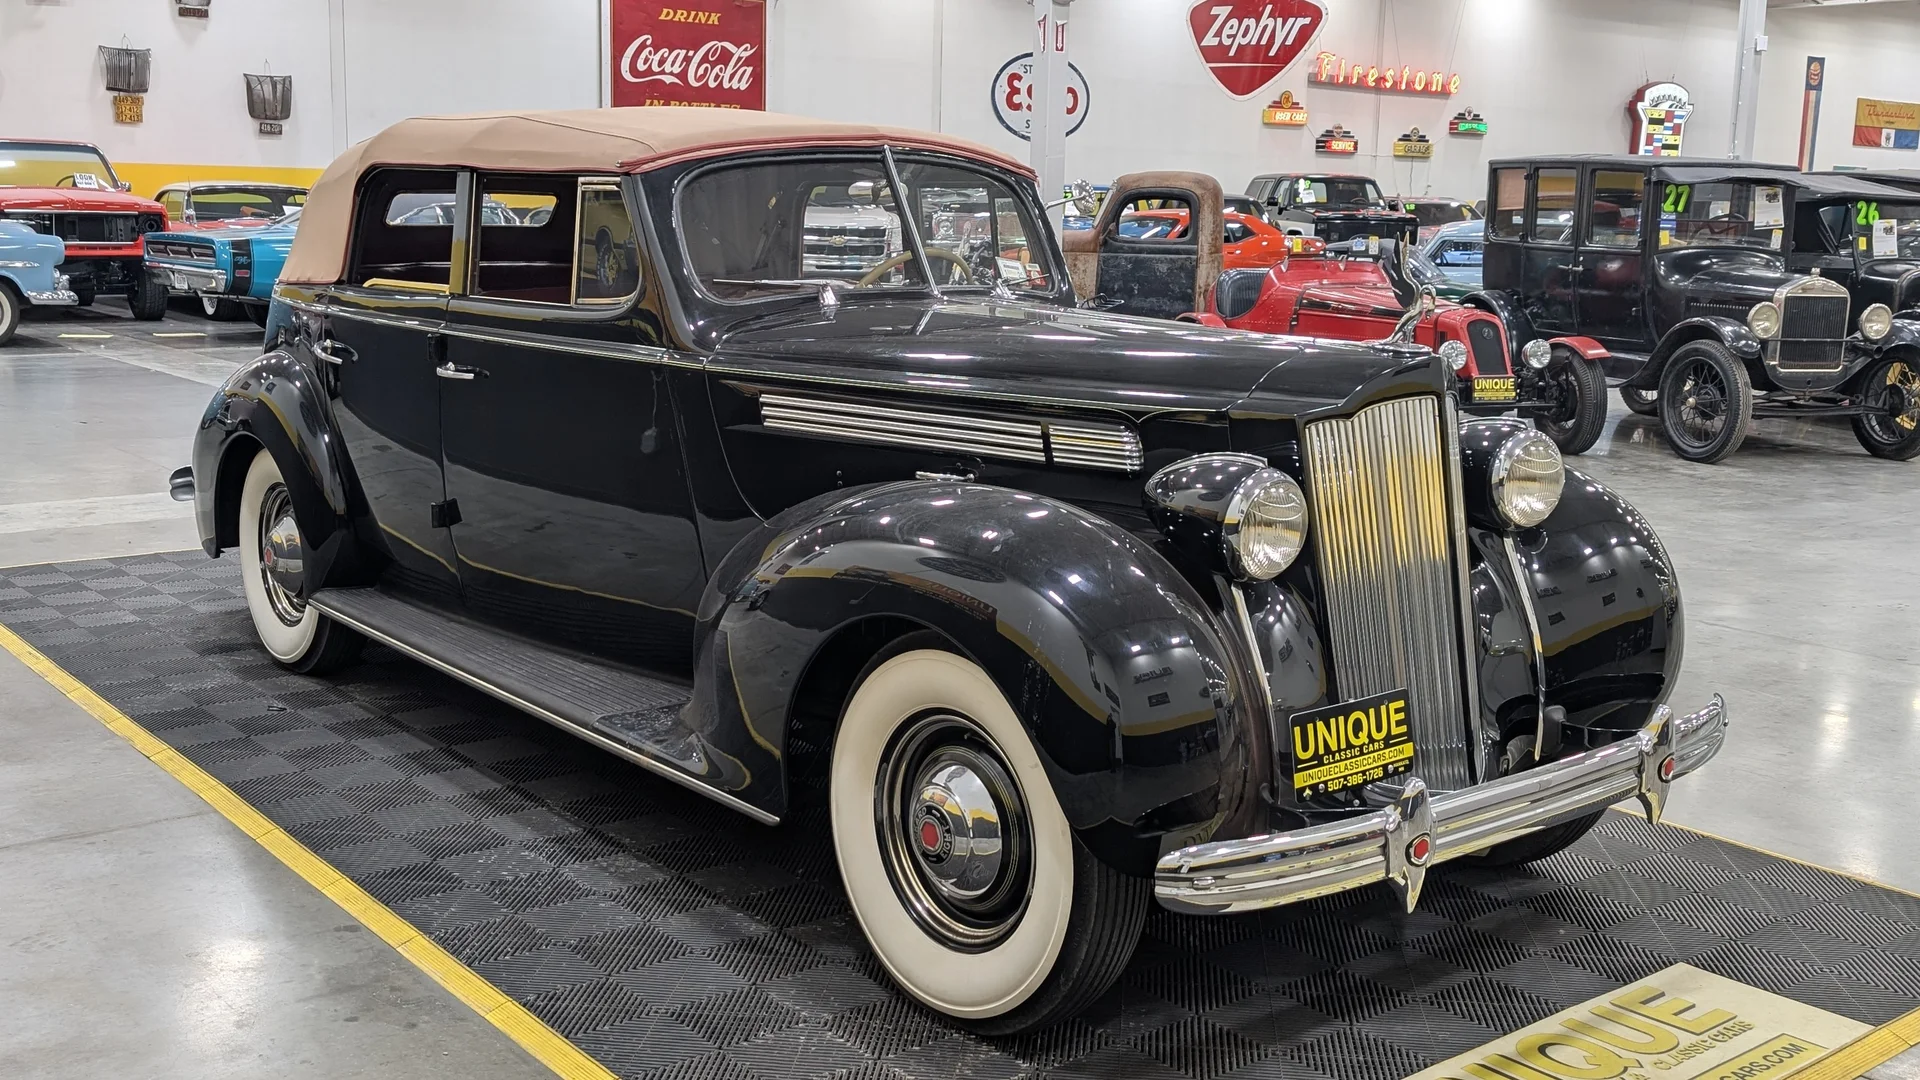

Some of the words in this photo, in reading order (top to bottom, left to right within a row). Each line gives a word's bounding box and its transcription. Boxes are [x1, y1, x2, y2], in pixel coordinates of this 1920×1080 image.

[658, 8, 722, 25] DRINK
[1200, 4, 1312, 57] Zephyr
[620, 34, 759, 91] Coca-Cola
[1316, 51, 1462, 94] Firestone
[1275, 111, 1291, 121] USED
[1291, 112, 1308, 122] CARS
[1331, 141, 1355, 151] SERVICE
[1662, 184, 1691, 213] 27
[1856, 200, 1880, 226] 26
[1474, 378, 1515, 390] UNIQUE
[1293, 700, 1408, 760] UNIQUE
[1302, 747, 1405, 784] UNIQUECLASSICCARS.COM
[1323, 747, 1361, 764] CLASSIC
[1363, 740, 1385, 753] CARS
[1327, 767, 1384, 792] 507-386-1726
[1652, 1038, 1713, 1071] CLASSIC
[1708, 1021, 1756, 1047] CARS
